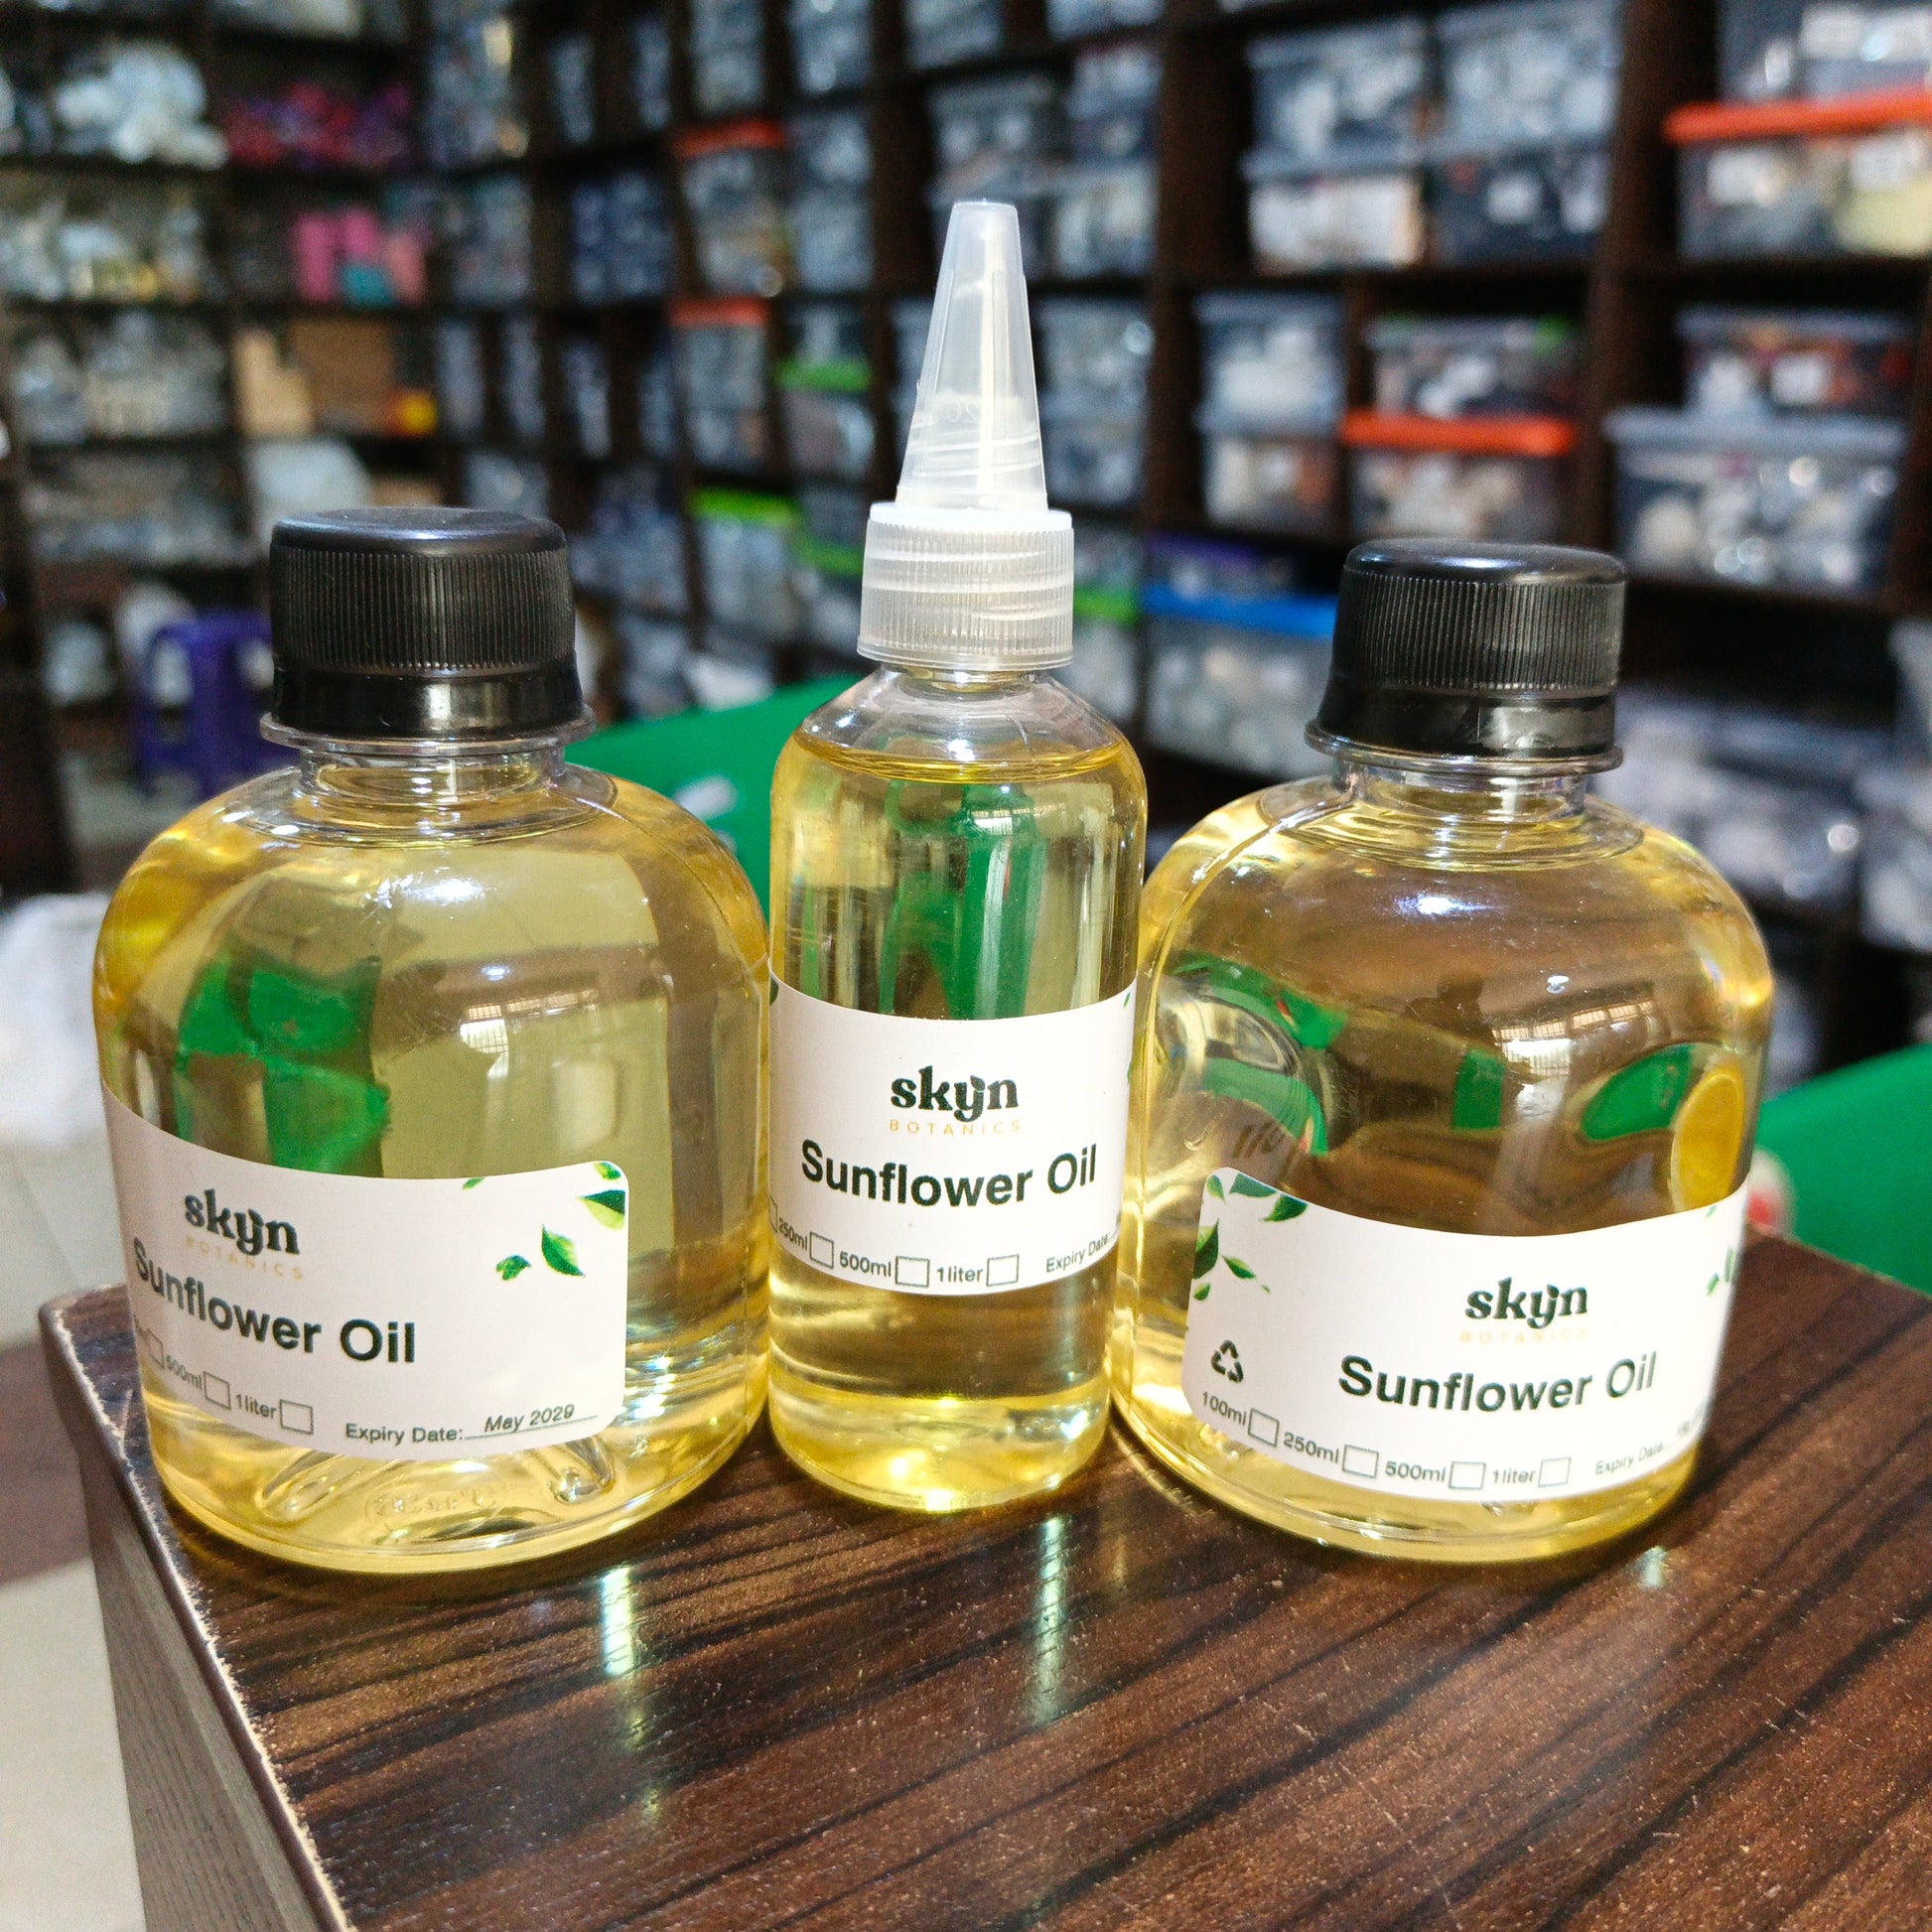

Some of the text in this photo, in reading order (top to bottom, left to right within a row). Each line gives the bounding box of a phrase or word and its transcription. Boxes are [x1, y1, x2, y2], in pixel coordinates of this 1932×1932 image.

[891, 1065, 1019, 1122] skyn
[890, 1119, 1021, 1136] BOTANICS
[801, 1140, 1097, 1207] Sunflower Oil
[185, 1188, 300, 1256] skyn
[778, 1217, 808, 1251] 250ml
[839, 1251, 892, 1278] 500ml
[1045, 1249, 1085, 1273] Expiry
[133, 1236, 415, 1363] Sunflower Oil
[1464, 1277, 1587, 1329] skyn
[1338, 1351, 1657, 1413] Sunflower Oil
[345, 1422, 405, 1447] Expiry
[412, 1426, 464, 1443] Date:
[483, 1415, 525, 1433] May
[1202, 1391, 1248, 1426] 100ml
[1283, 1432, 1339, 1464] 250ml
[1385, 1459, 1447, 1483] 500ml
